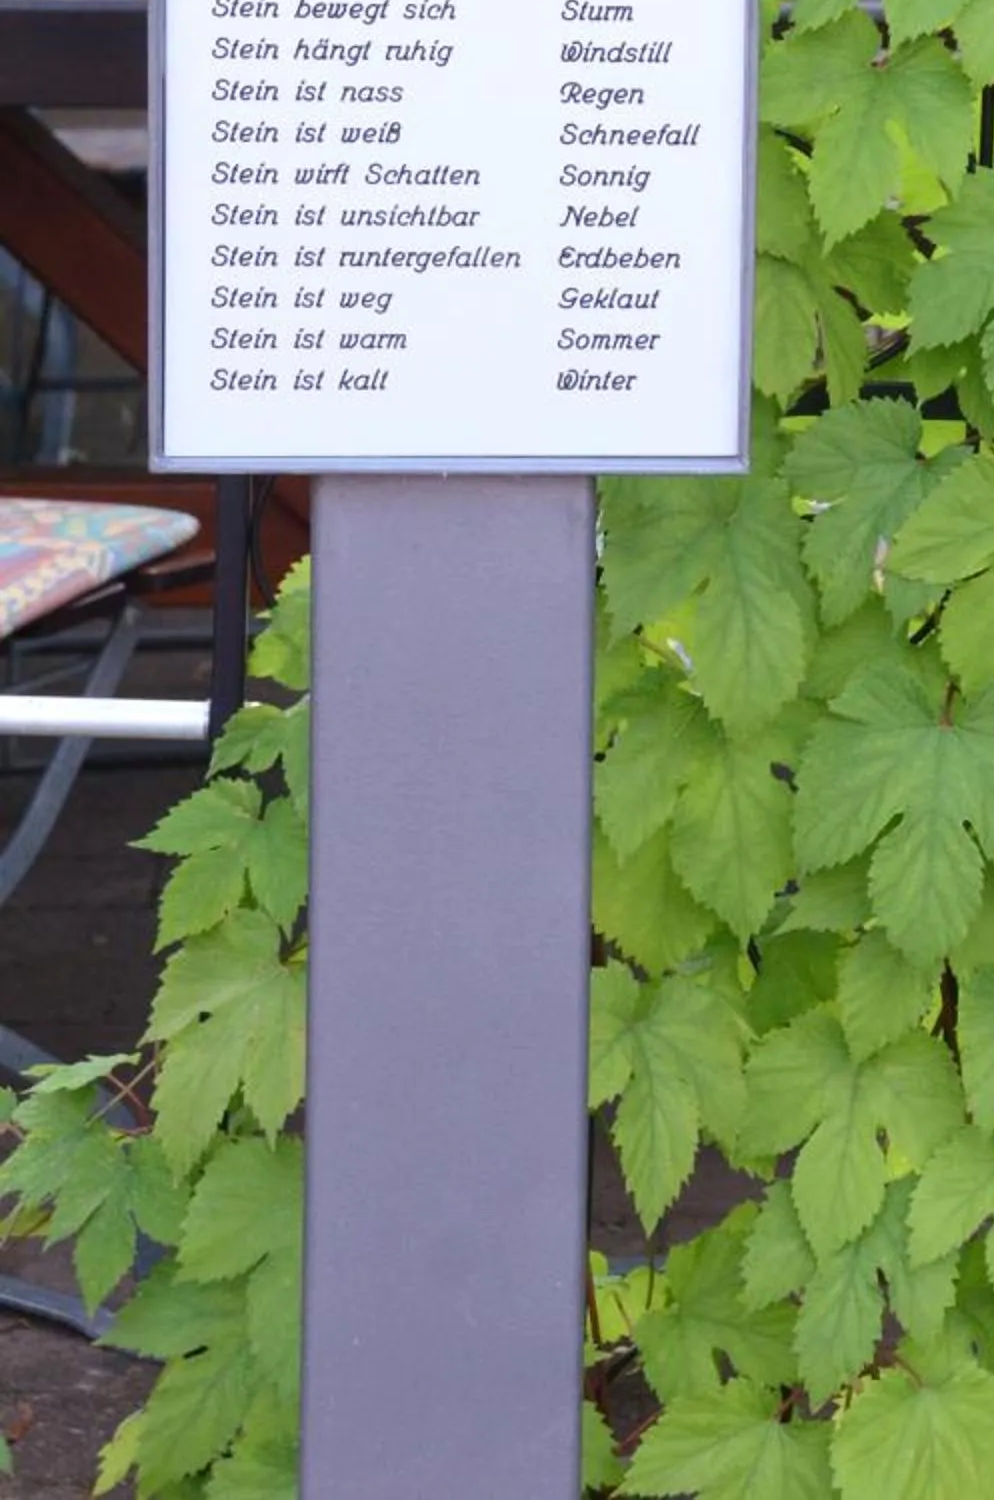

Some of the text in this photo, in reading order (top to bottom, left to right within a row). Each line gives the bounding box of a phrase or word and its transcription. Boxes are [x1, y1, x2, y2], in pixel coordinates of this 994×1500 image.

[210, 36, 454, 68] Stein hängt ruhig
[560, 40, 674, 64] Windstill
[211, 78, 404, 103] Stein ist nass
[559, 80, 644, 111] Regen
[210, 119, 402, 144] Stein ist weiß
[558, 122, 701, 147] Schneefall
[210, 160, 480, 186] Stein wirft Schatten
[558, 163, 652, 194] Sonnig
[210, 202, 481, 228] Stein ist unsichtbar
[558, 204, 640, 228] Nebel
[210, 244, 522, 274] Stein ist runtergefallen
[557, 245, 681, 270] Erdbeben
[210, 285, 394, 314] Stein ist weg
[558, 286, 660, 310] Geklaut
[210, 326, 408, 350] Stein ist warm
[556, 327, 662, 351] Sommer
[209, 368, 389, 392] Stein ist kalt
[556, 368, 638, 392] Winter
